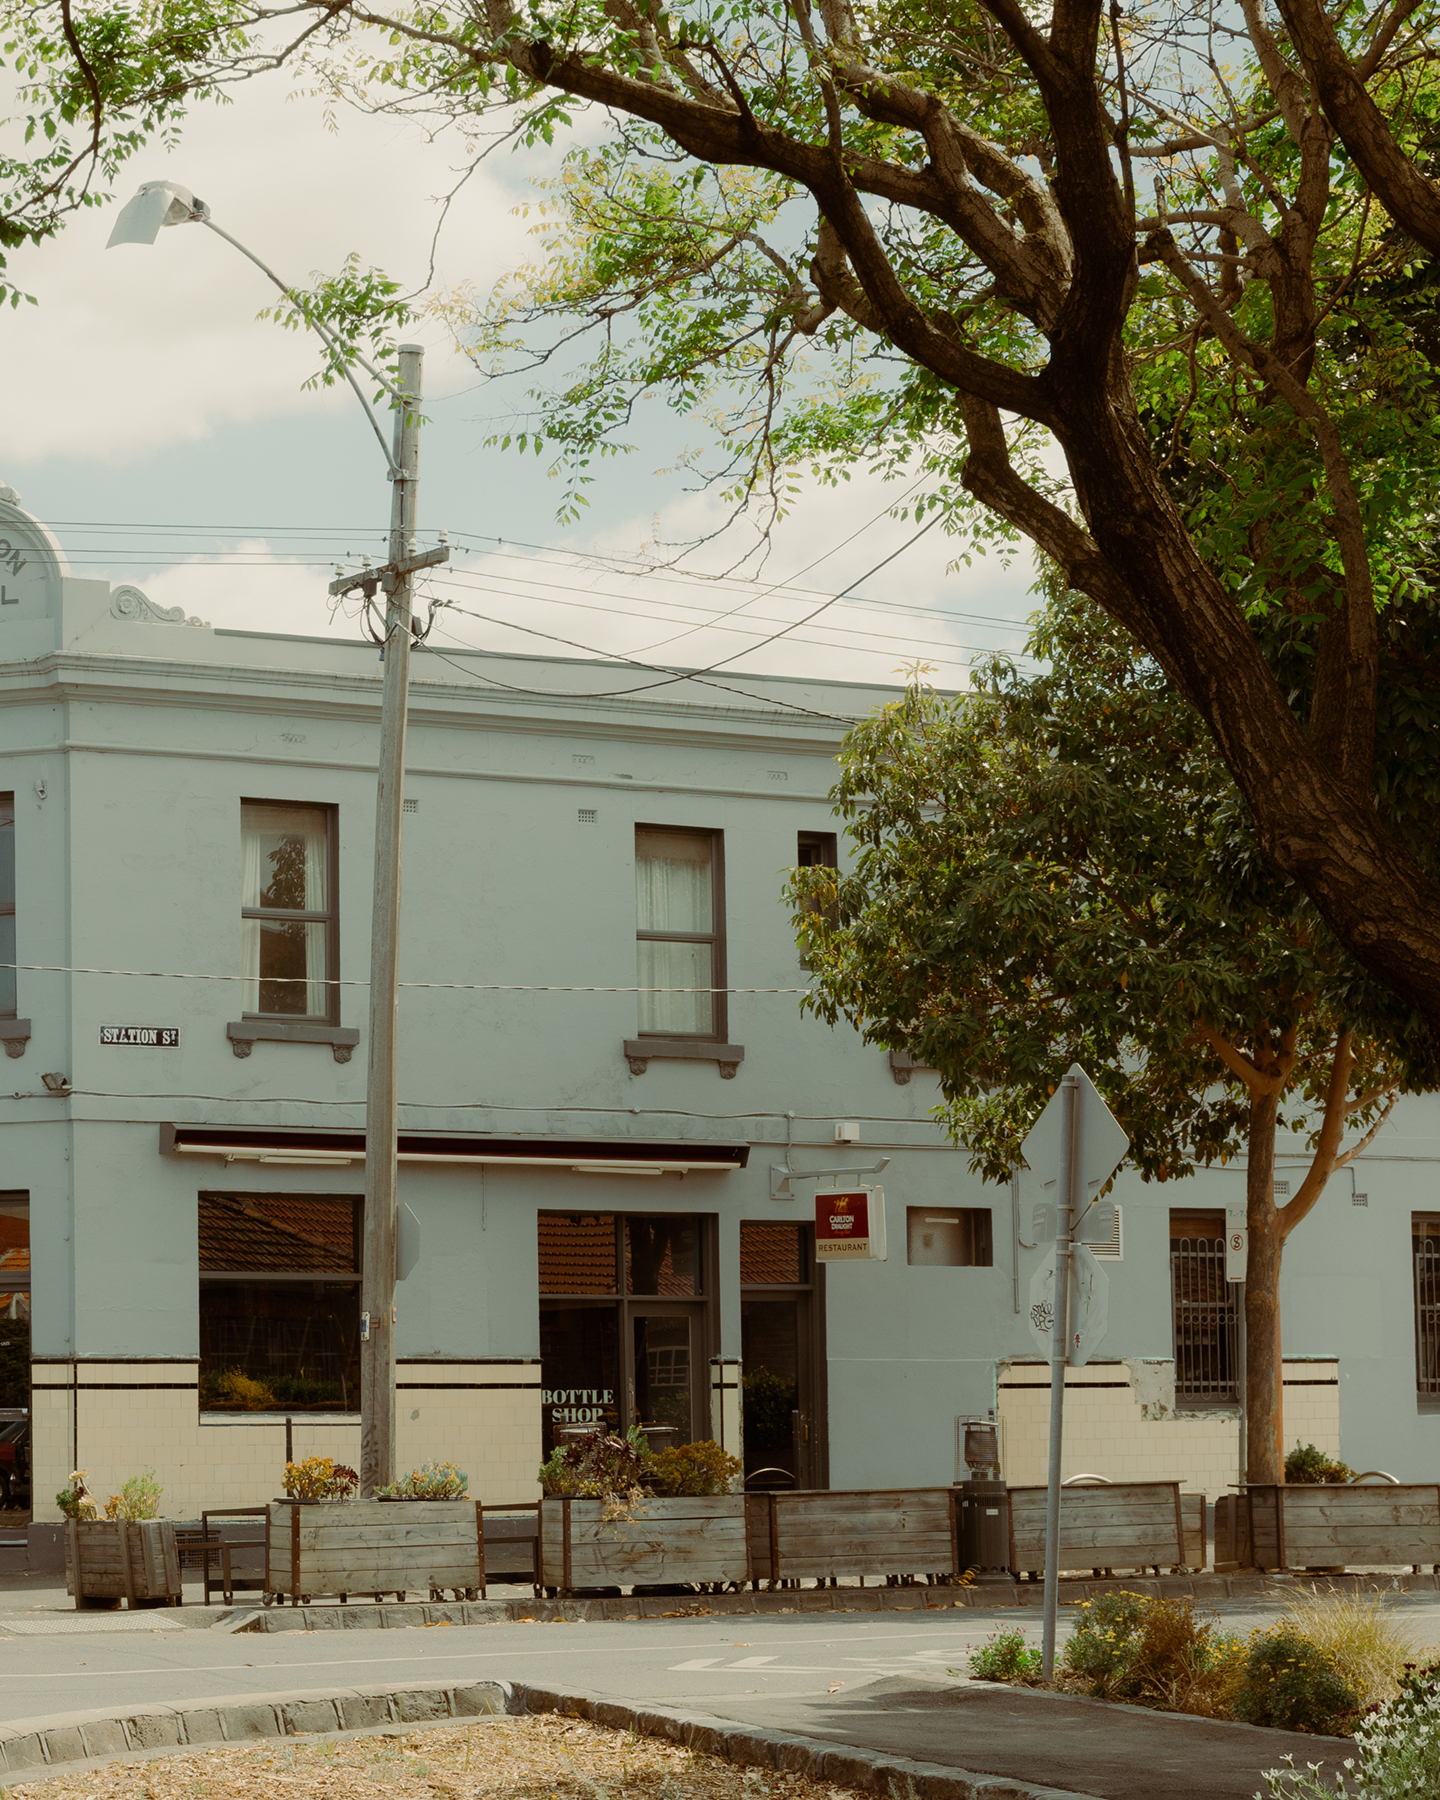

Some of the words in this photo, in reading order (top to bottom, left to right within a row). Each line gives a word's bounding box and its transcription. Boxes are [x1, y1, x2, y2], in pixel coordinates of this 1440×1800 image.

[103, 1028, 158, 1044] STATION
[829, 1215, 855, 1223] CARLTON
[818, 1243, 868, 1252] RESTAURANT
[541, 1389, 614, 1404] BOTTLE
[551, 1407, 604, 1423] SHOP
